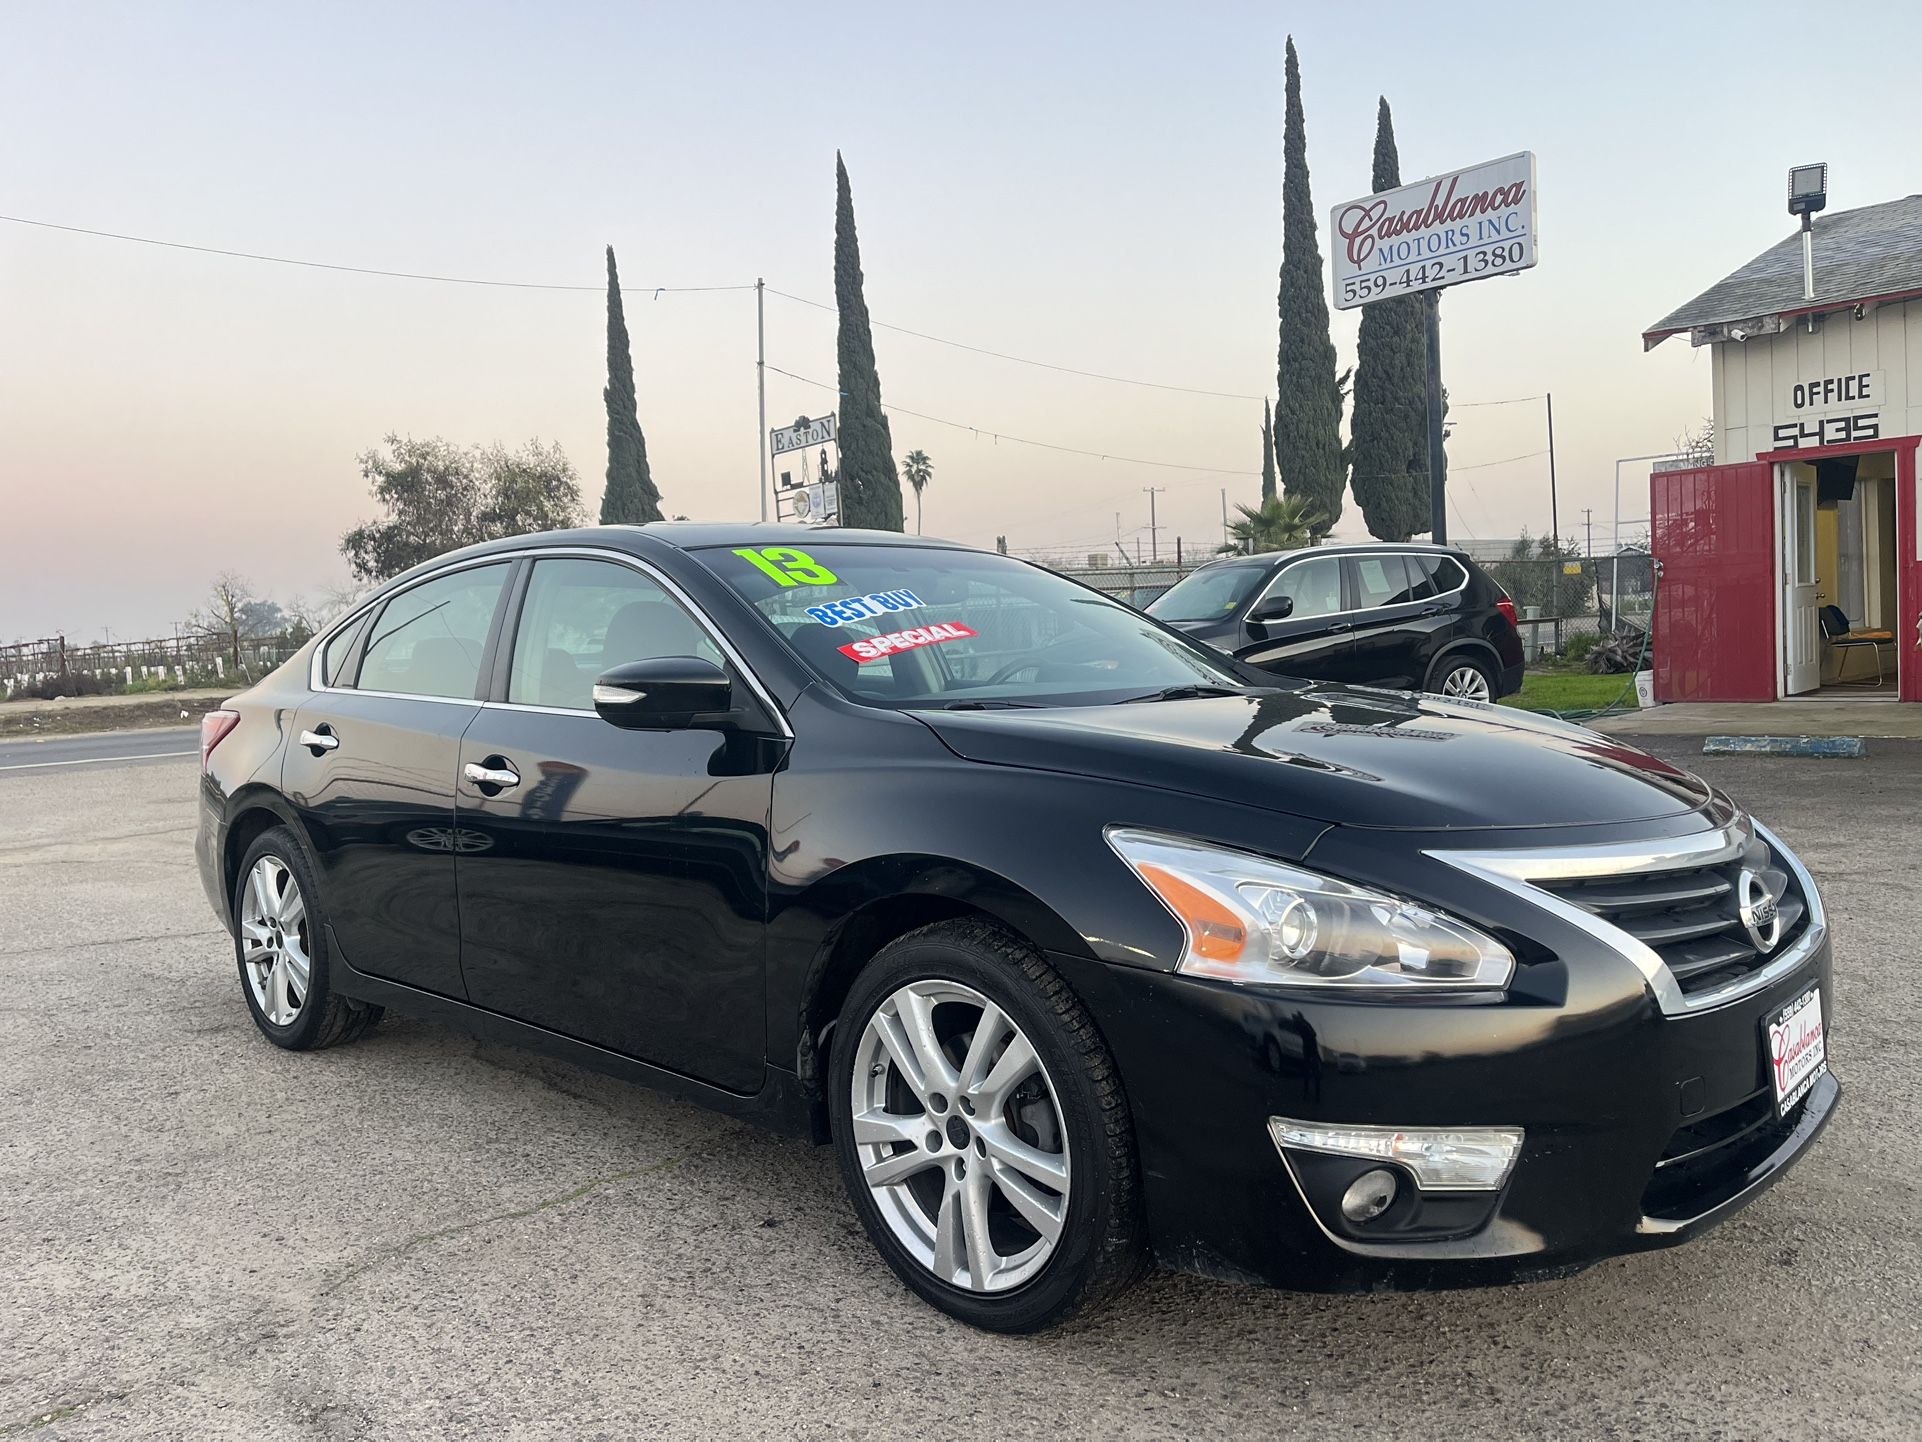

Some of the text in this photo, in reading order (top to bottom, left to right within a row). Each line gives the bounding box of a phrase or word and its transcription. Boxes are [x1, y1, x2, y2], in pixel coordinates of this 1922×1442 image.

[1338, 175, 1527, 271] Casablanca
[1377, 211, 1525, 266] MOTORS INC.
[1343, 241, 1524, 302] 559-442-1380
[1793, 373, 1871, 409] OFFICE
[1773, 412, 1879, 451] 5435
[731, 547, 838, 588] 13
[806, 589, 925, 627] BEST BUY
[851, 622, 970, 659] SPECIAL
[1771, 1020, 1822, 1093] Casablanca
[1789, 1048, 1812, 1080] MOTORS
[1780, 1077, 1810, 1117] CASABLANCA
